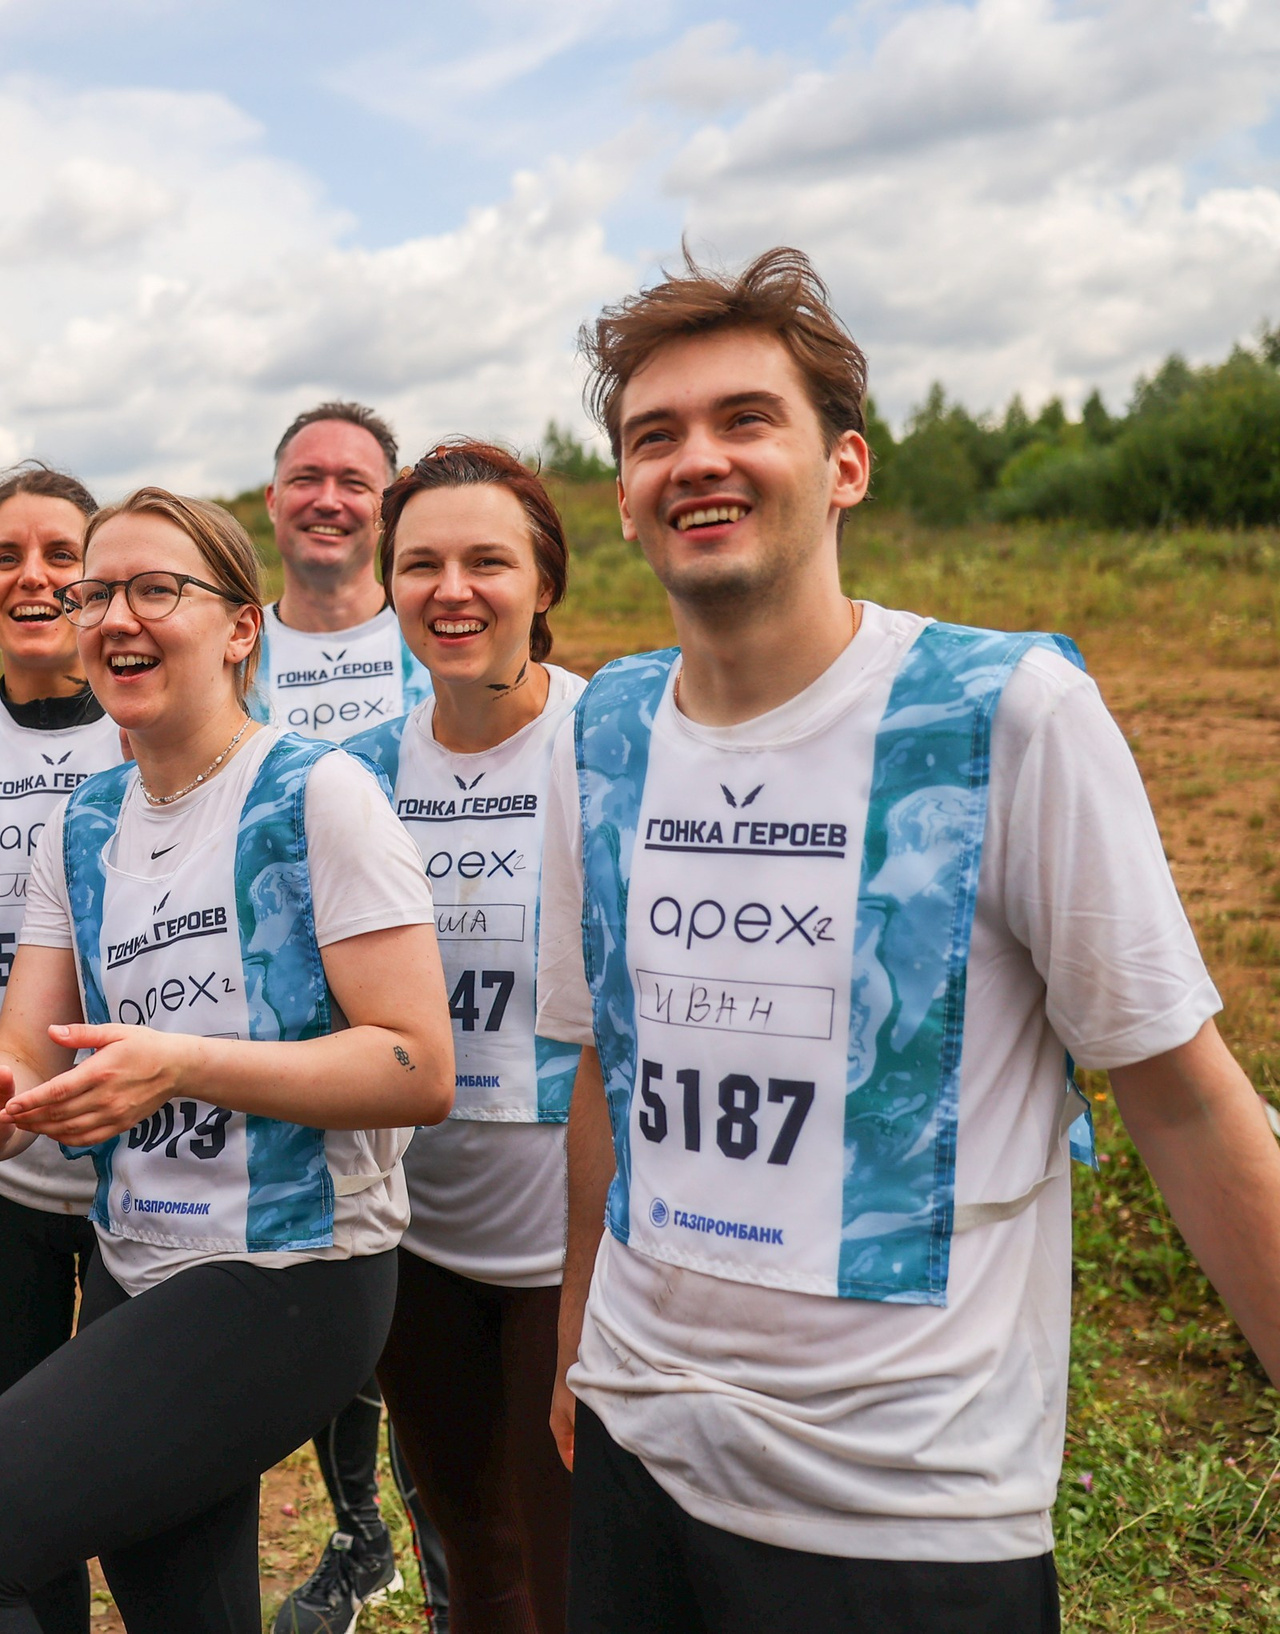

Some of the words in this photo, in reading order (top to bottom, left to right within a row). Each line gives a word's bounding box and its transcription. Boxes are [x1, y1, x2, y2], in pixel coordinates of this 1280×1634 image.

[277, 670, 328, 684] ГОНКА
[333, 661, 394, 676] ГЕРОЕВ
[287, 697, 384, 730] apex
[53, 773, 95, 788] ГЕР
[397, 799, 456, 815] ГОНКА
[461, 795, 538, 814] ГЕРОЕВ
[646, 819, 724, 845] ГОНКА
[733, 822, 847, 847] ГЕРОЕВ
[513, 854, 526, 870] 2
[107, 932, 148, 963] ГОНКА
[153, 906, 227, 941] ГЕРОЕВ
[649, 896, 819, 949] apex
[221, 978, 237, 993] 2
[639, 1059, 816, 1166] 5187
[134, 1198, 211, 1215] ГАЗПРОМБАНК
[673, 1210, 784, 1245] ГАЗПРОМБАНК
